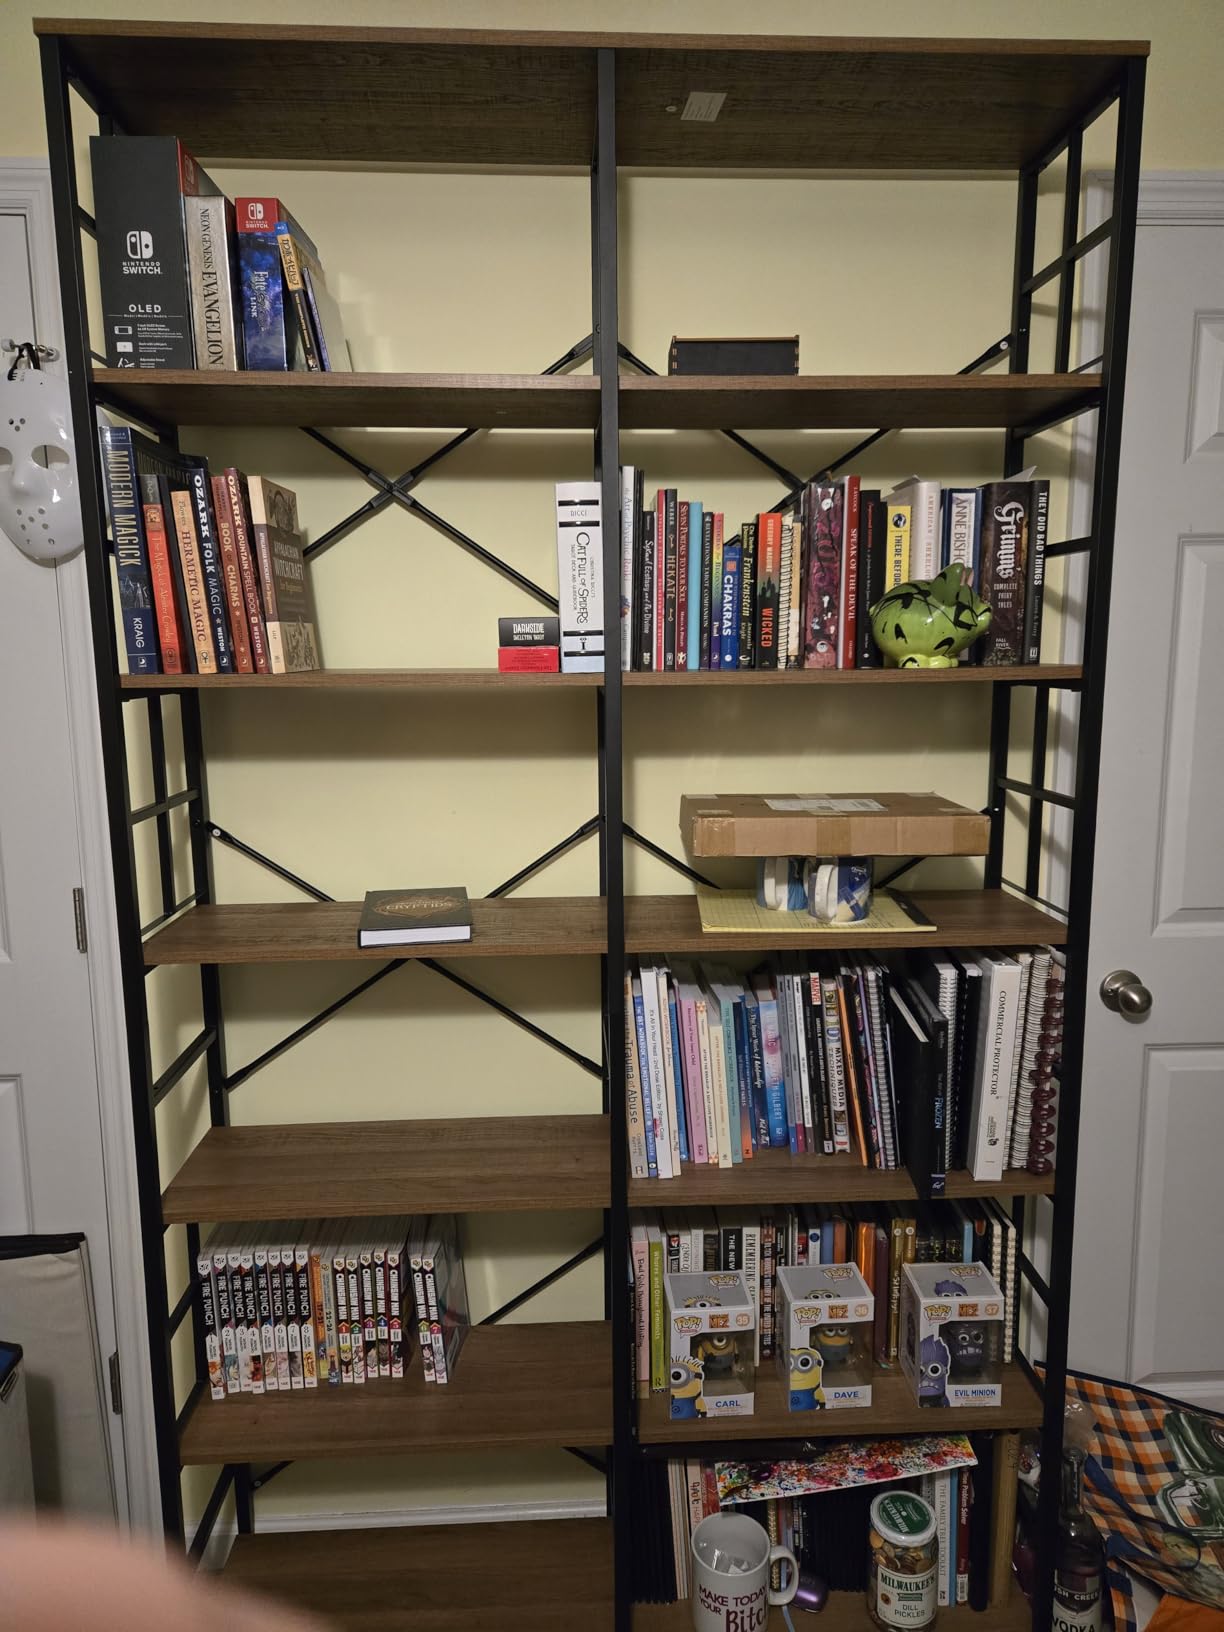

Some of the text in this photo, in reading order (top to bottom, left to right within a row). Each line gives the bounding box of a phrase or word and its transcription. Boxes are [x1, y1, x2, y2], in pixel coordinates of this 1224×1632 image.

[200, 208, 224, 365] NEON GENESIS EVANGELION
[254, 271, 269, 290] Fate
[129, 304, 161, 313] OLED
[107, 450, 142, 566] MODERN MAGICK
[624, 497, 632, 511] Art
[955, 500, 968, 531] ANNE
[1039, 492, 1047, 513] THEY
[576, 532, 590, 555] CAT
[641, 540, 654, 564] Sexual
[679, 505, 688, 602] SEVEN PORTALS TO YOUR SOUL
[895, 535, 903, 557] THERE
[994, 502, 1024, 578] Grimm's
[1036, 534, 1044, 552] BAD
[178, 501, 205, 642] Flowers HERMETIC MAGIC
[194, 475, 225, 651] OZARK FOLK MAGIC WESTON
[221, 522, 233, 552] BOOK
[227, 565, 239, 607] CHARMS
[228, 476, 262, 653] OZARK MOUNTAIN SPELL BOOK WESTON
[577, 558, 586, 577] FULL
[667, 556, 675, 599] HEKATE
[850, 559, 856, 571] OF
[1034, 554, 1044, 585] THINGS
[741, 557, 754, 616] Frankenstein
[577, 588, 589, 624] SPIDERS
[723, 575, 733, 635] CHAKRAS
[133, 617, 144, 648] KRAIG
[513, 623, 544, 633] DARKSIDE
[761, 608, 773, 647] WICKED
[811, 977, 820, 1003] MARVEL
[990, 991, 1007, 1095] COMMERCIAL PROTECTOR
[625, 1040, 635, 1079] Trauma
[835, 1048, 843, 1075] MIXED
[829, 1048, 838, 1106] TECHNIQUES
[628, 1089, 638, 1124] Abuse
[773, 1093, 782, 1120] GILBERT
[934, 1097, 944, 1128] FROZEN
[746, 1234, 756, 1282] REMEMBERING
[218, 1276, 229, 1318] FIRE PUNCH
[272, 1274, 282, 1316] FIRE PUNCH
[336, 1273, 347, 1319] CHAINSAW MAN
[349, 1274, 359, 1320] CHAINSAW MAN
[362, 1269, 373, 1314] CHAINSAW MAN
[376, 1267, 384, 1298] CHAINSAW
[390, 1270, 399, 1316] CHAINSAW MAN
[414, 1273, 426, 1318] CHAINSAW MAN
[426, 1274, 438, 1320] CHAINSAW MAN
[204, 1299, 213, 1325] PUNCH
[235, 1292, 244, 1317] PUNCH
[246, 1294, 255, 1319] PUNCH
[260, 1291, 269, 1316] PUNCH
[794, 1307, 821, 1320] POP!
[924, 1305, 952, 1317] POP!
[674, 1317, 702, 1329] POP!
[737, 1316, 748, 1324] 35
[716, 1400, 740, 1408] CARL
[834, 1391, 859, 1399] DAVE
[972, 1389, 996, 1397] MINION
[700, 1585, 767, 1607] MAKE TODAY
